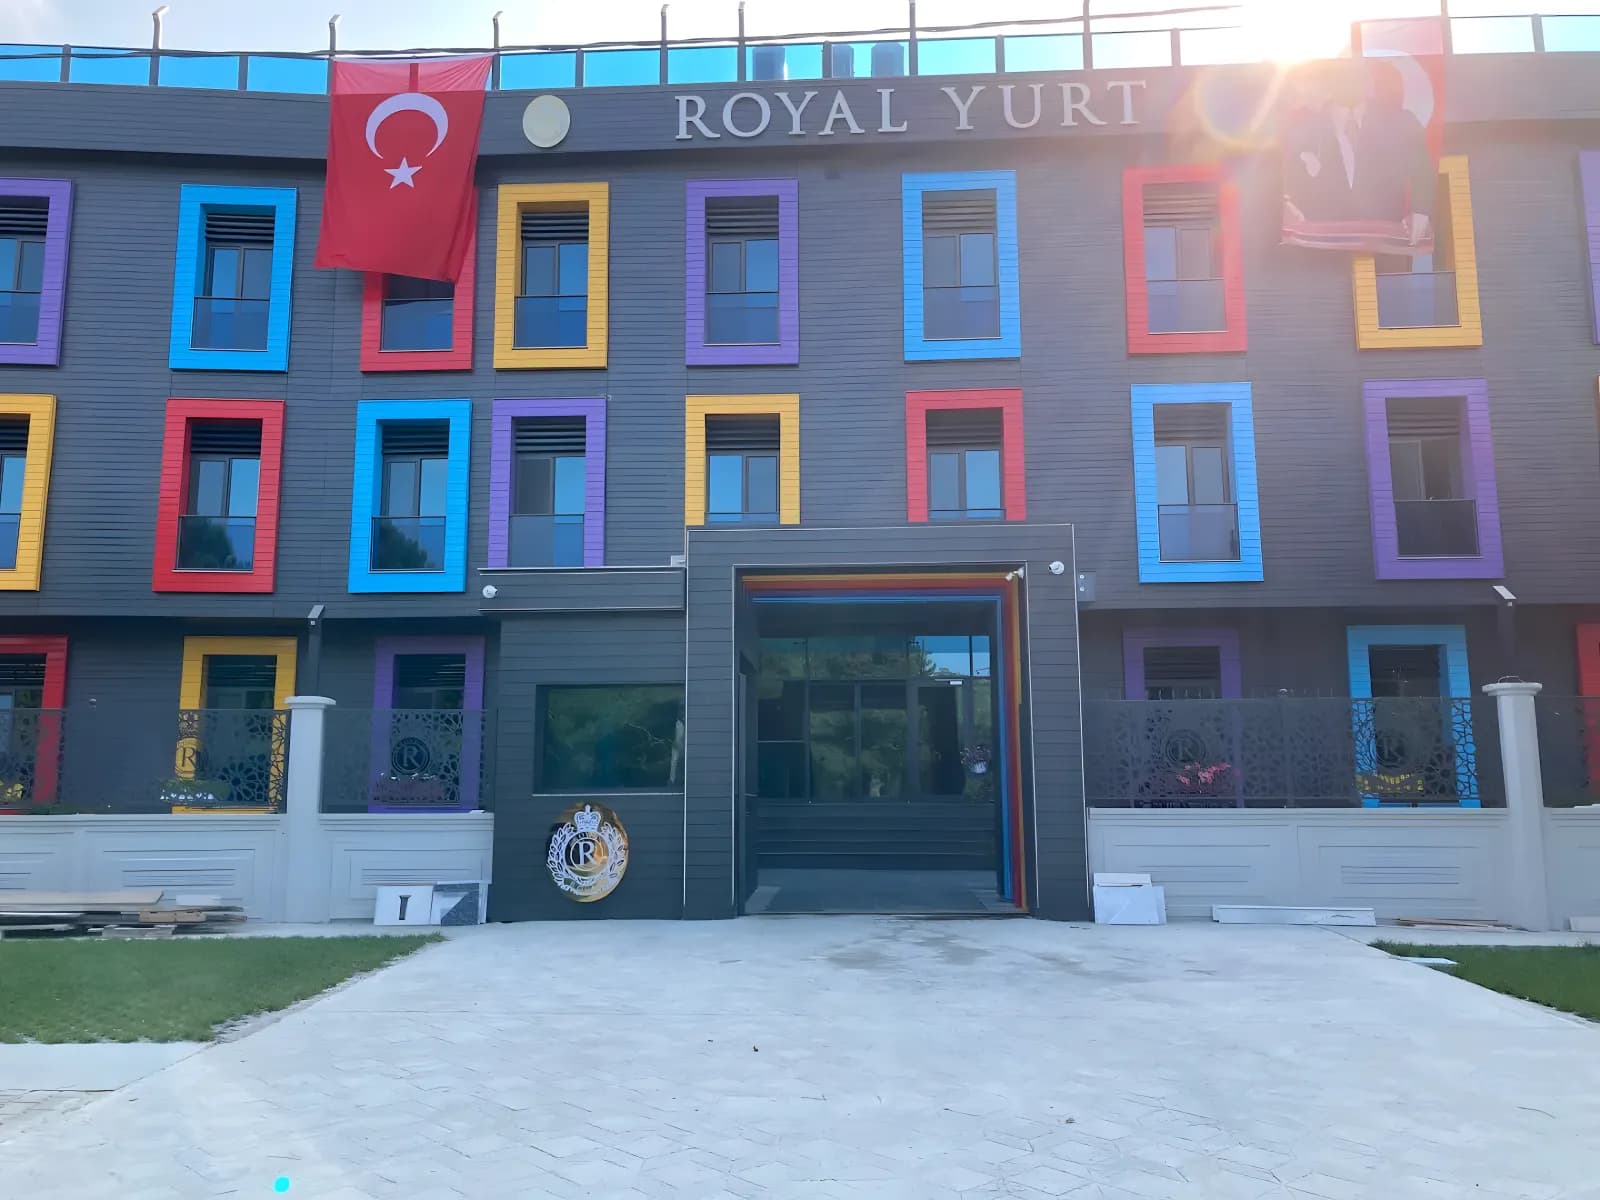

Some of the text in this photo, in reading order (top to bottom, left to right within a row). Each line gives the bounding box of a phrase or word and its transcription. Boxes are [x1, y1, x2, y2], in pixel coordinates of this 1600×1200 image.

[674, 80, 1147, 140] ROYAL YURT
[181, 746, 197, 768] R
[402, 745, 421, 768] R
[577, 841, 599, 865] R
